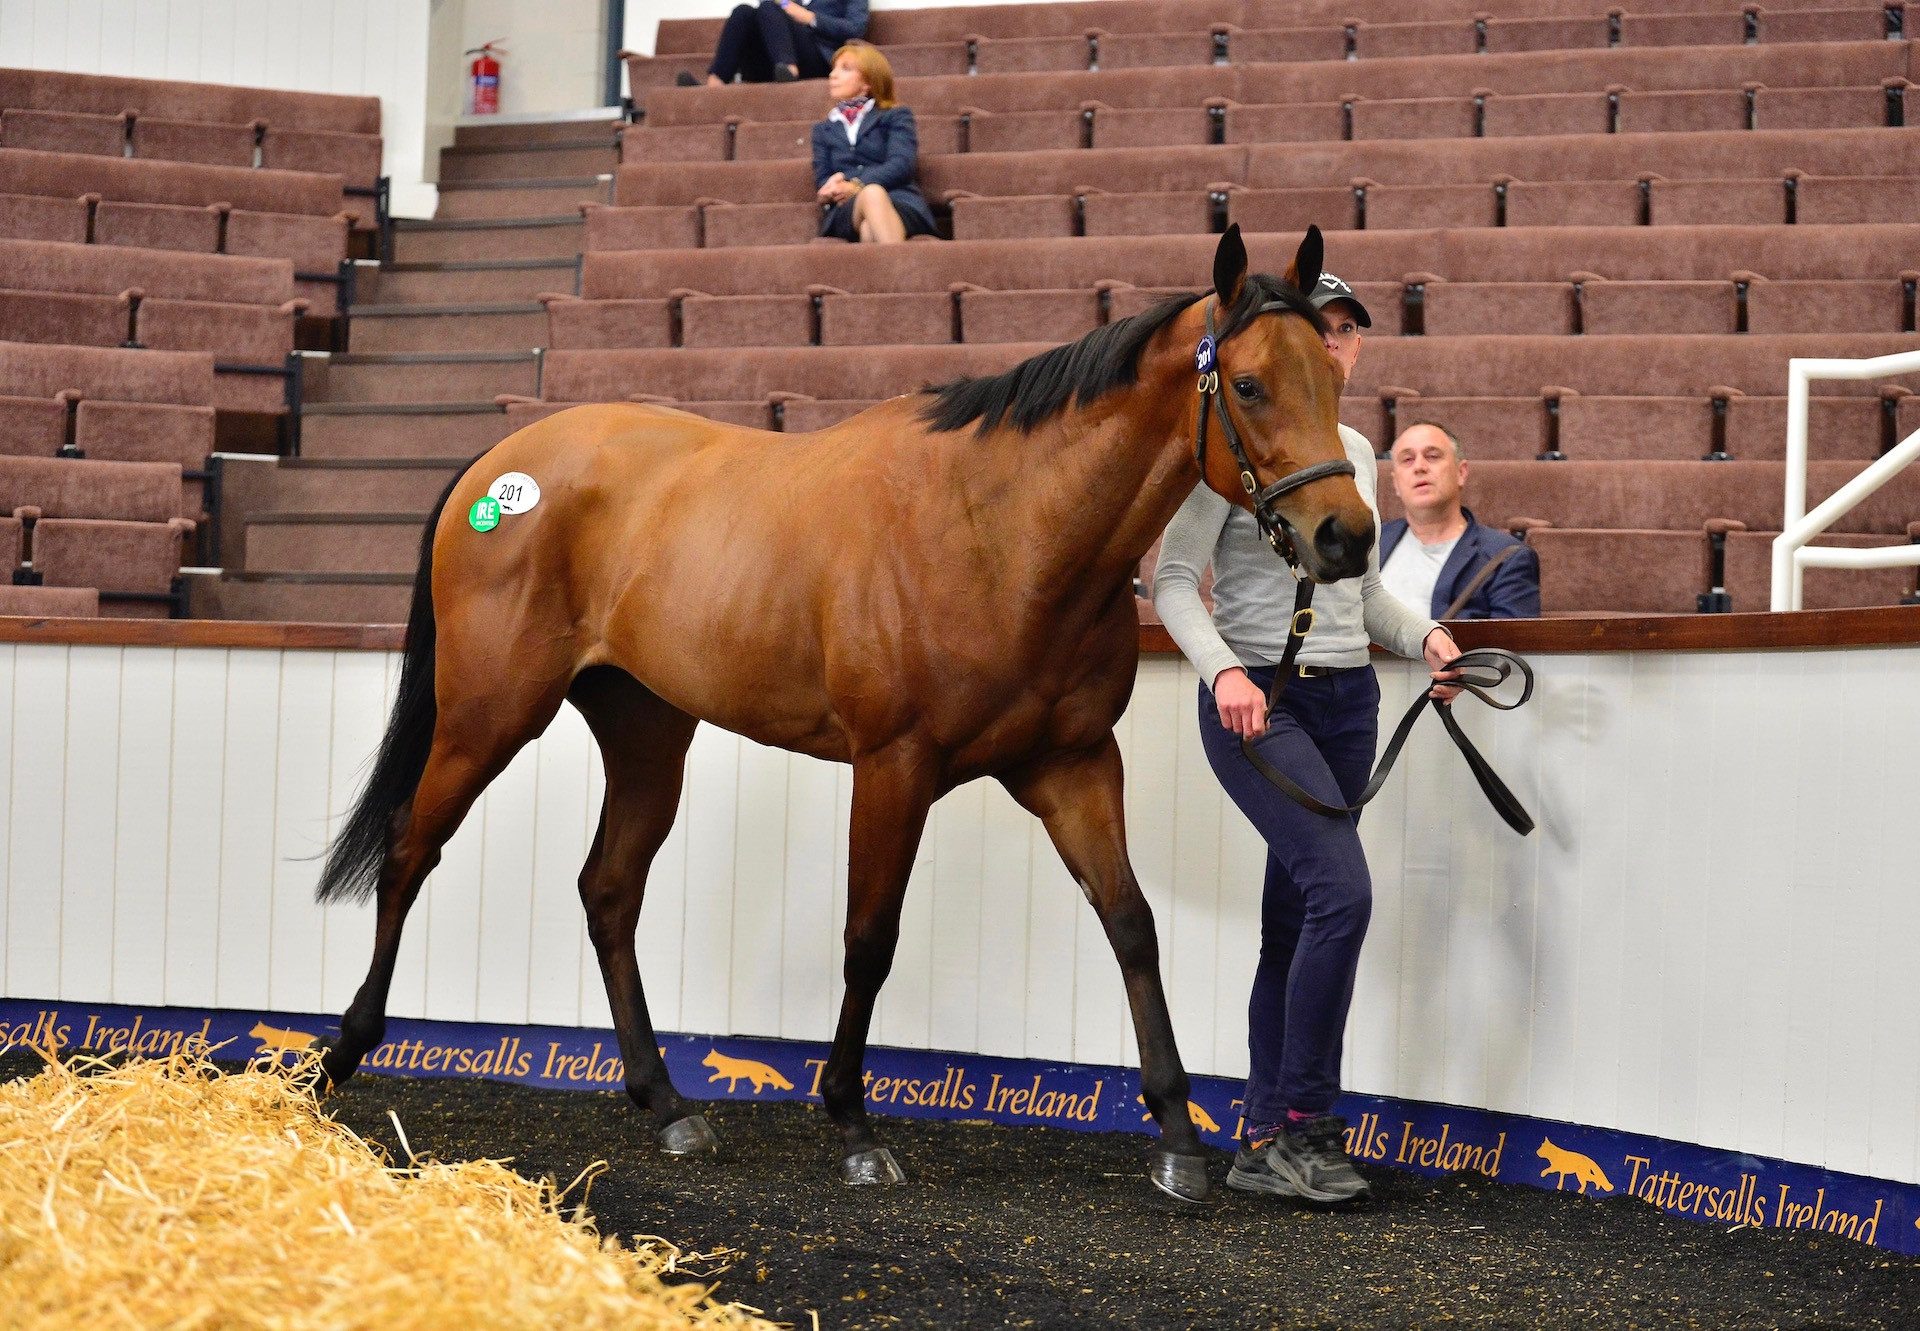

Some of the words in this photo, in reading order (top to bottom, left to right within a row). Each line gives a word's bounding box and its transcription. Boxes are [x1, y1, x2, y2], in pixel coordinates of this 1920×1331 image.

[1198, 347, 1211, 370] 201
[499, 484, 523, 502] 201
[80, 1015, 211, 1055] Ireland
[804, 1058, 976, 1110] Ttersalls
[983, 1073, 1103, 1122] Ireland
[1395, 1121, 1506, 1177] Ireland
[1624, 1154, 1767, 1227] Tattersalls
[1775, 1184, 1883, 1246] Ireland
